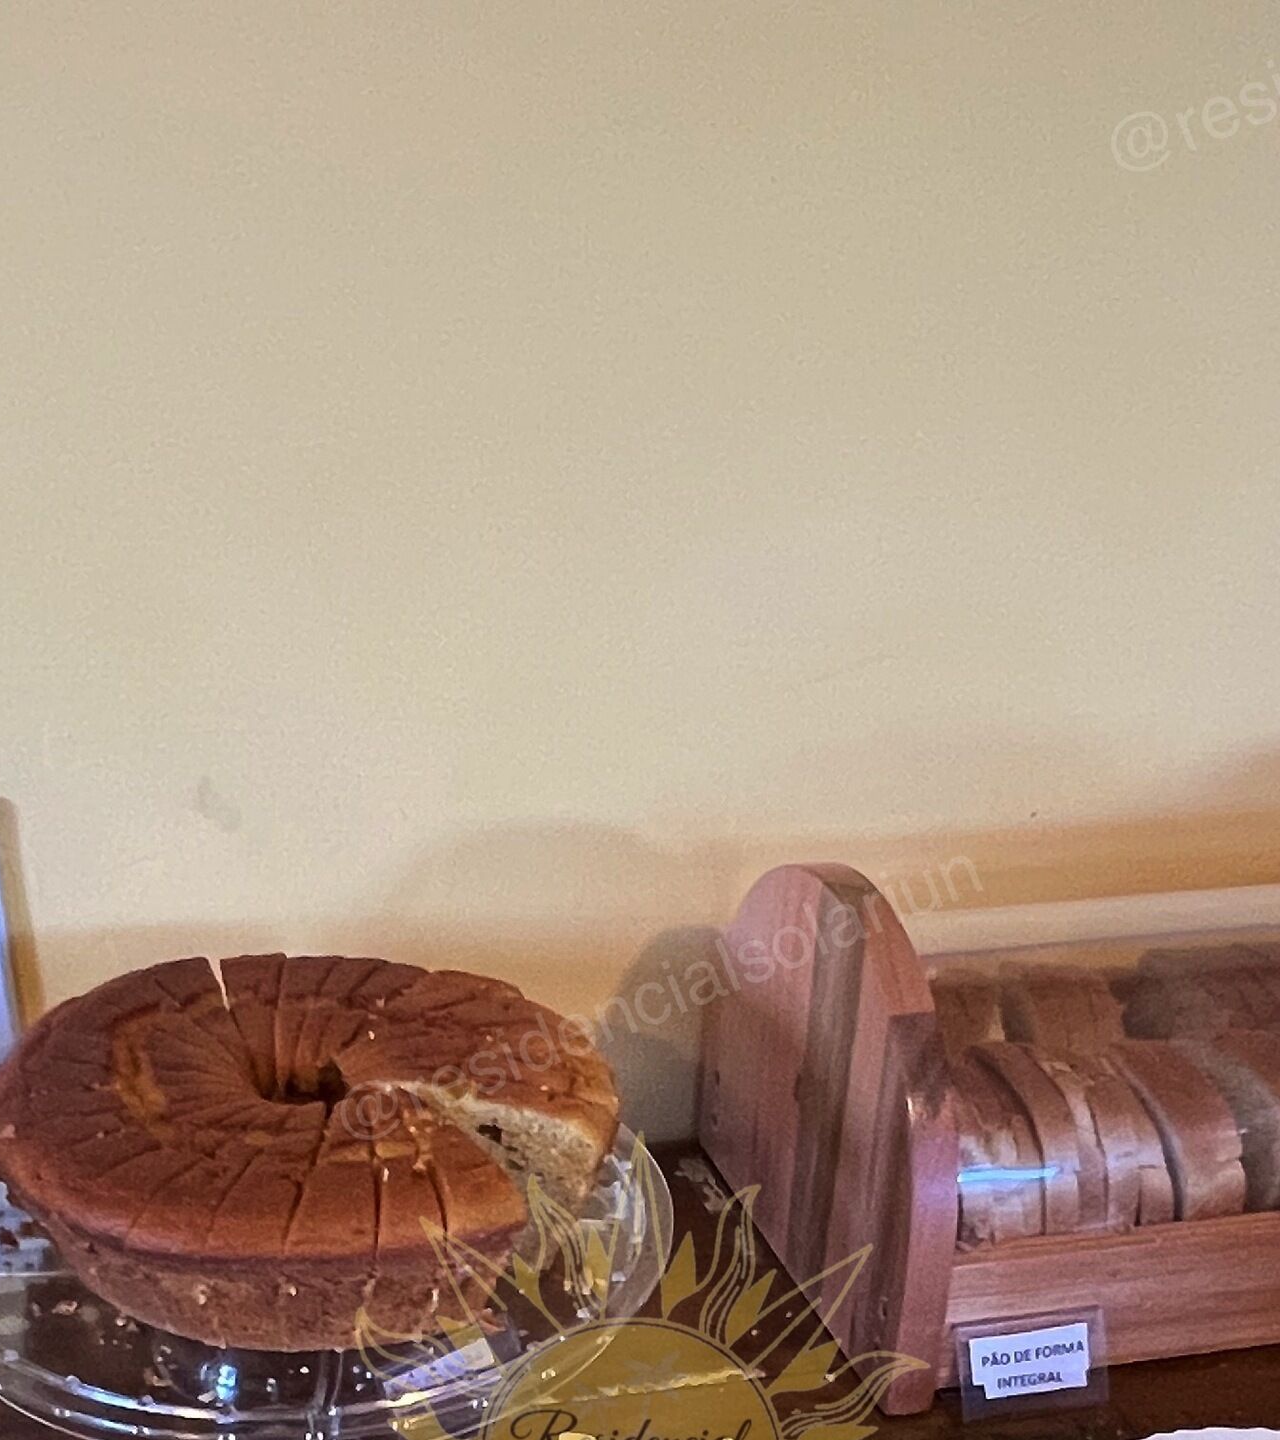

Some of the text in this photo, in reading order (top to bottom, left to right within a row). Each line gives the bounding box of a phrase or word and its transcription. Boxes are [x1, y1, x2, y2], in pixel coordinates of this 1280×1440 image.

[981, 1339, 1085, 1368] PÃO DE FORMA
[996, 1371, 1063, 1389] INTEGRAL
